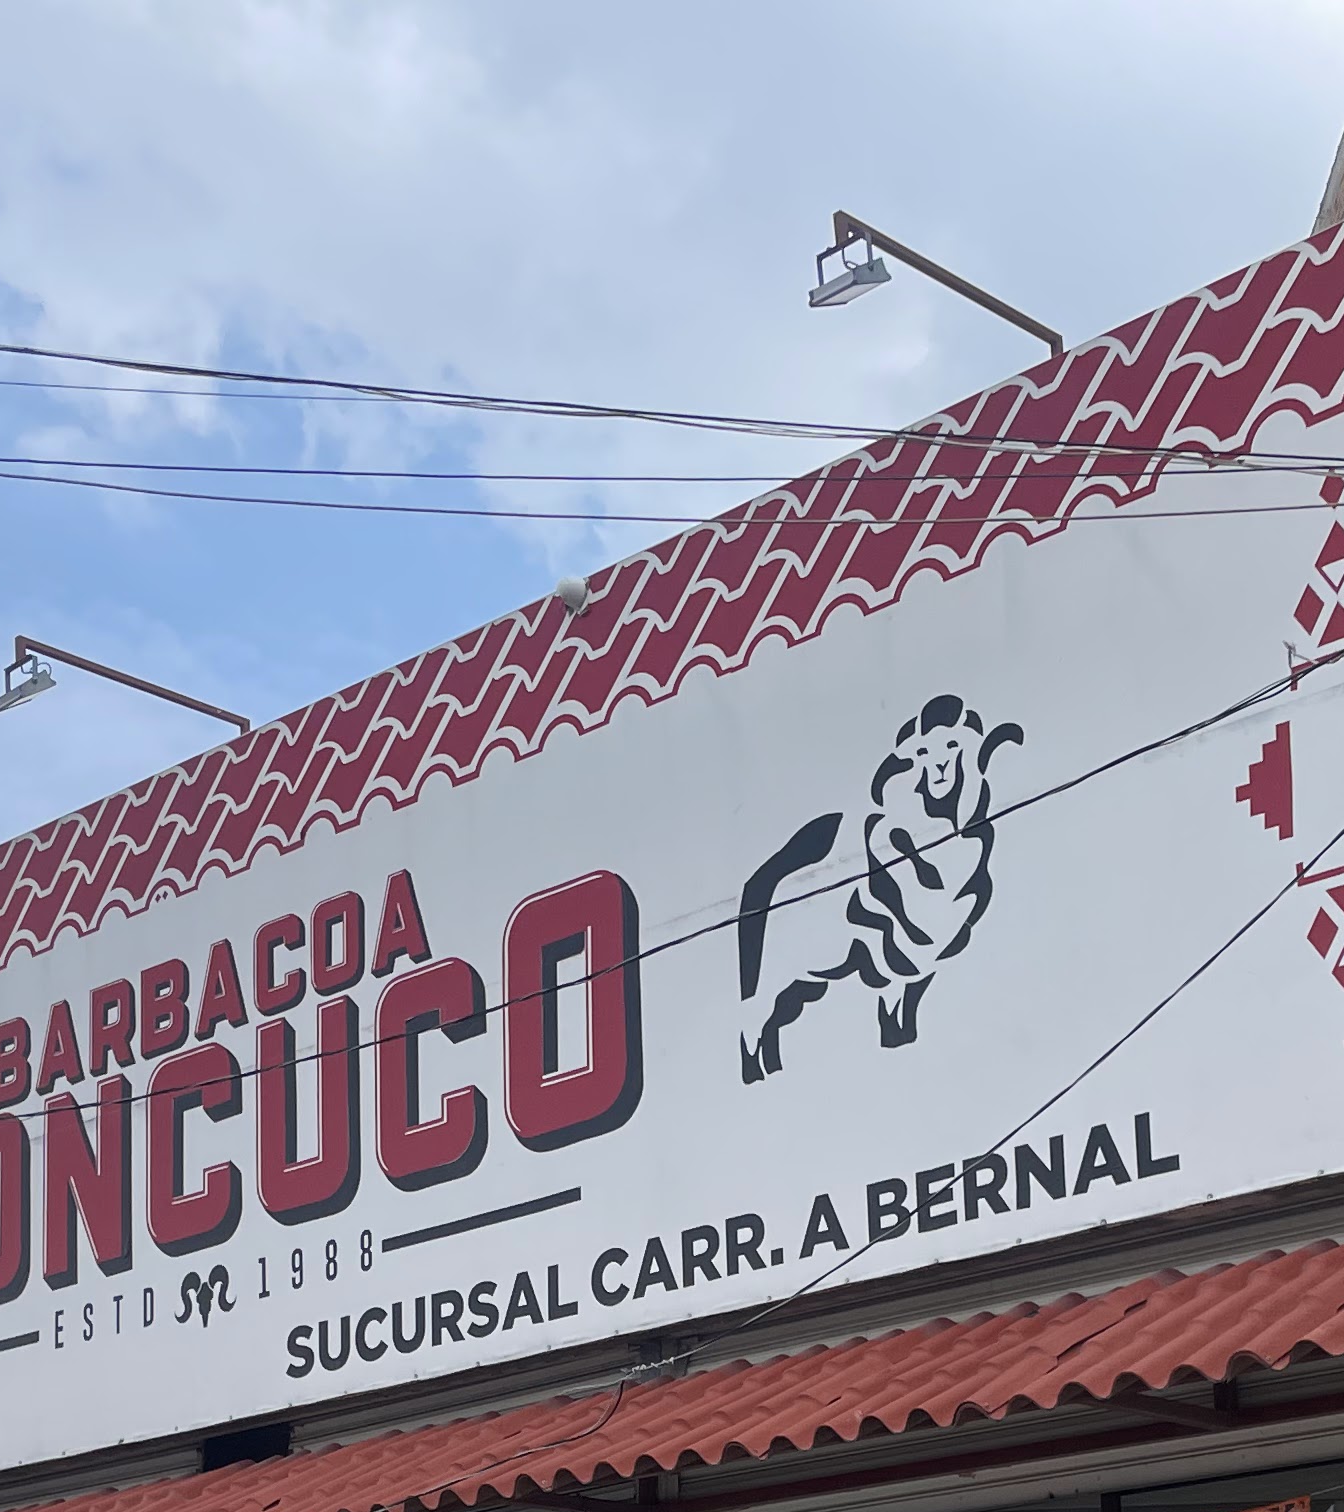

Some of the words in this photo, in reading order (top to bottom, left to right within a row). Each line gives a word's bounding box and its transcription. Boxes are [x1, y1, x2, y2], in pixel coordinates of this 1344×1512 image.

[54, 1287, 154, 1349] ESTD
[257, 1229, 373, 1299] 1988
[286, 1264, 578, 1379] SUCURSAL
[591, 1212, 785, 1307] CARR.
[800, 1193, 851, 1259] A
[866, 1112, 1180, 1242] BERNAL
